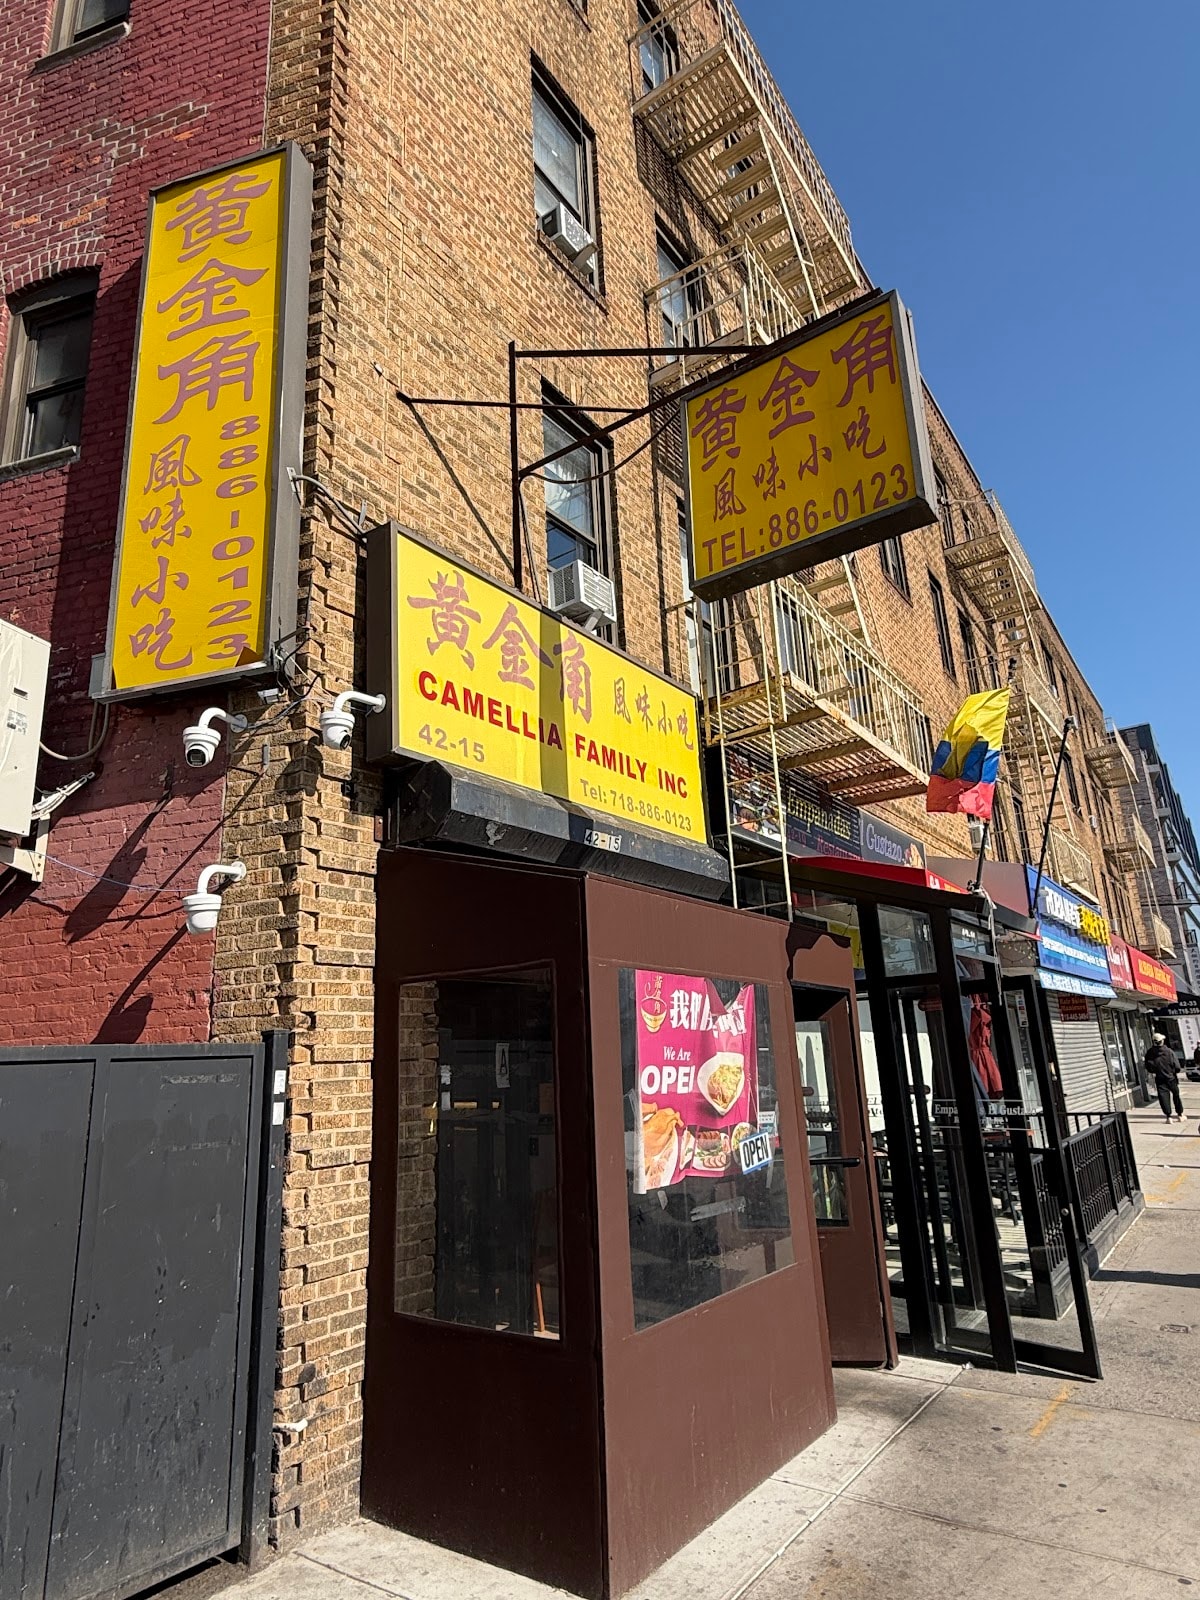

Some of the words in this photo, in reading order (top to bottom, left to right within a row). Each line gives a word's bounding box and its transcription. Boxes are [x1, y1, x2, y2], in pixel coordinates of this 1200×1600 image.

[711, 405, 887, 524] 風味小吃
[128, 434, 202, 673] 風味小吃
[206, 415, 262, 661] 886-0123
[418, 670, 563, 751] CAMELLIA
[574, 732, 647, 783] FAMILY
[657, 767, 688, 799] INC
[418, 723, 486, 764] 42-15
[613, 676, 695, 751] 風味小吃
[584, 828, 621, 851] 42-15
[663, 1046, 676, 1061] We
[676, 1047, 692, 1062] Are
[743, 1134, 769, 1168] OPEN
